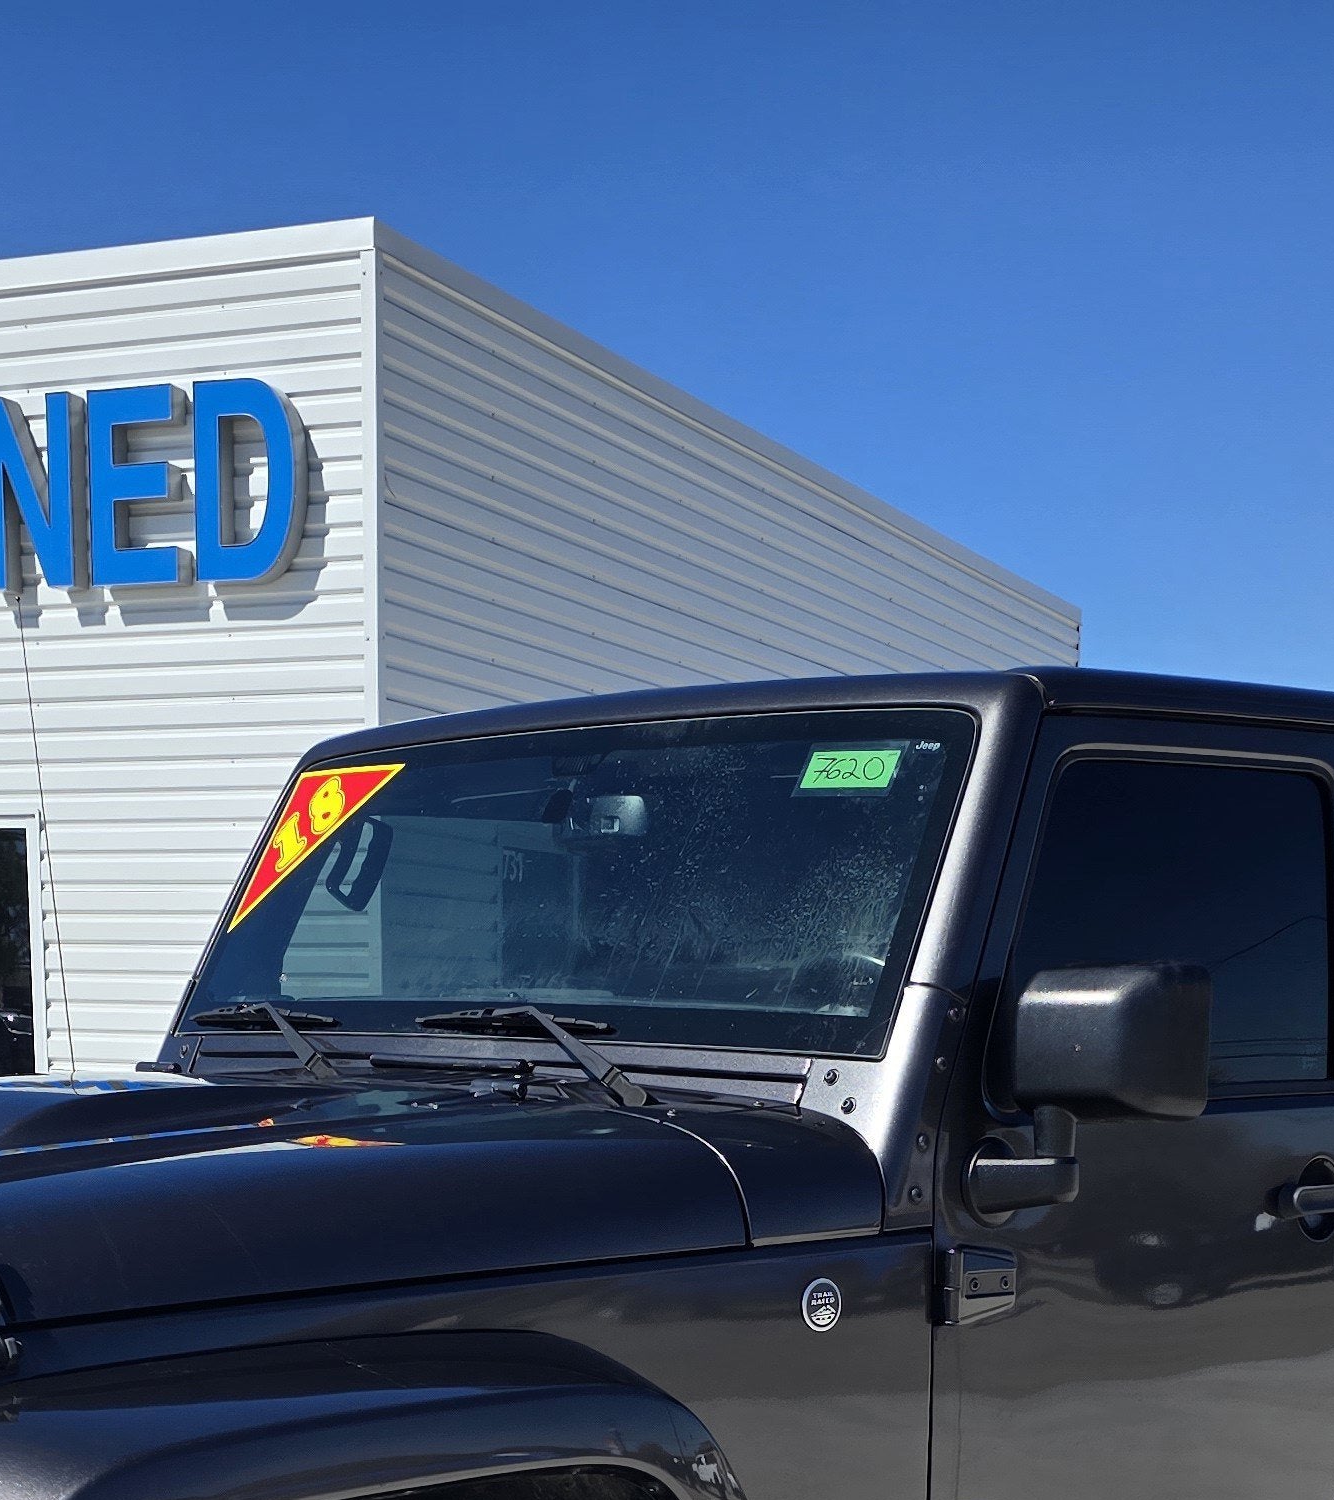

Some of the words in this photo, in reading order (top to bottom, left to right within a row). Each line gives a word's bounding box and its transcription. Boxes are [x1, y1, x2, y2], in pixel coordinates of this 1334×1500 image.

[915, 740, 941, 751] Jeep
[812, 756, 885, 784] 7620
[273, 775, 346, 873] 18
[812, 1291, 834, 1299] TRAIL
[810, 1297, 835, 1306] RATED
